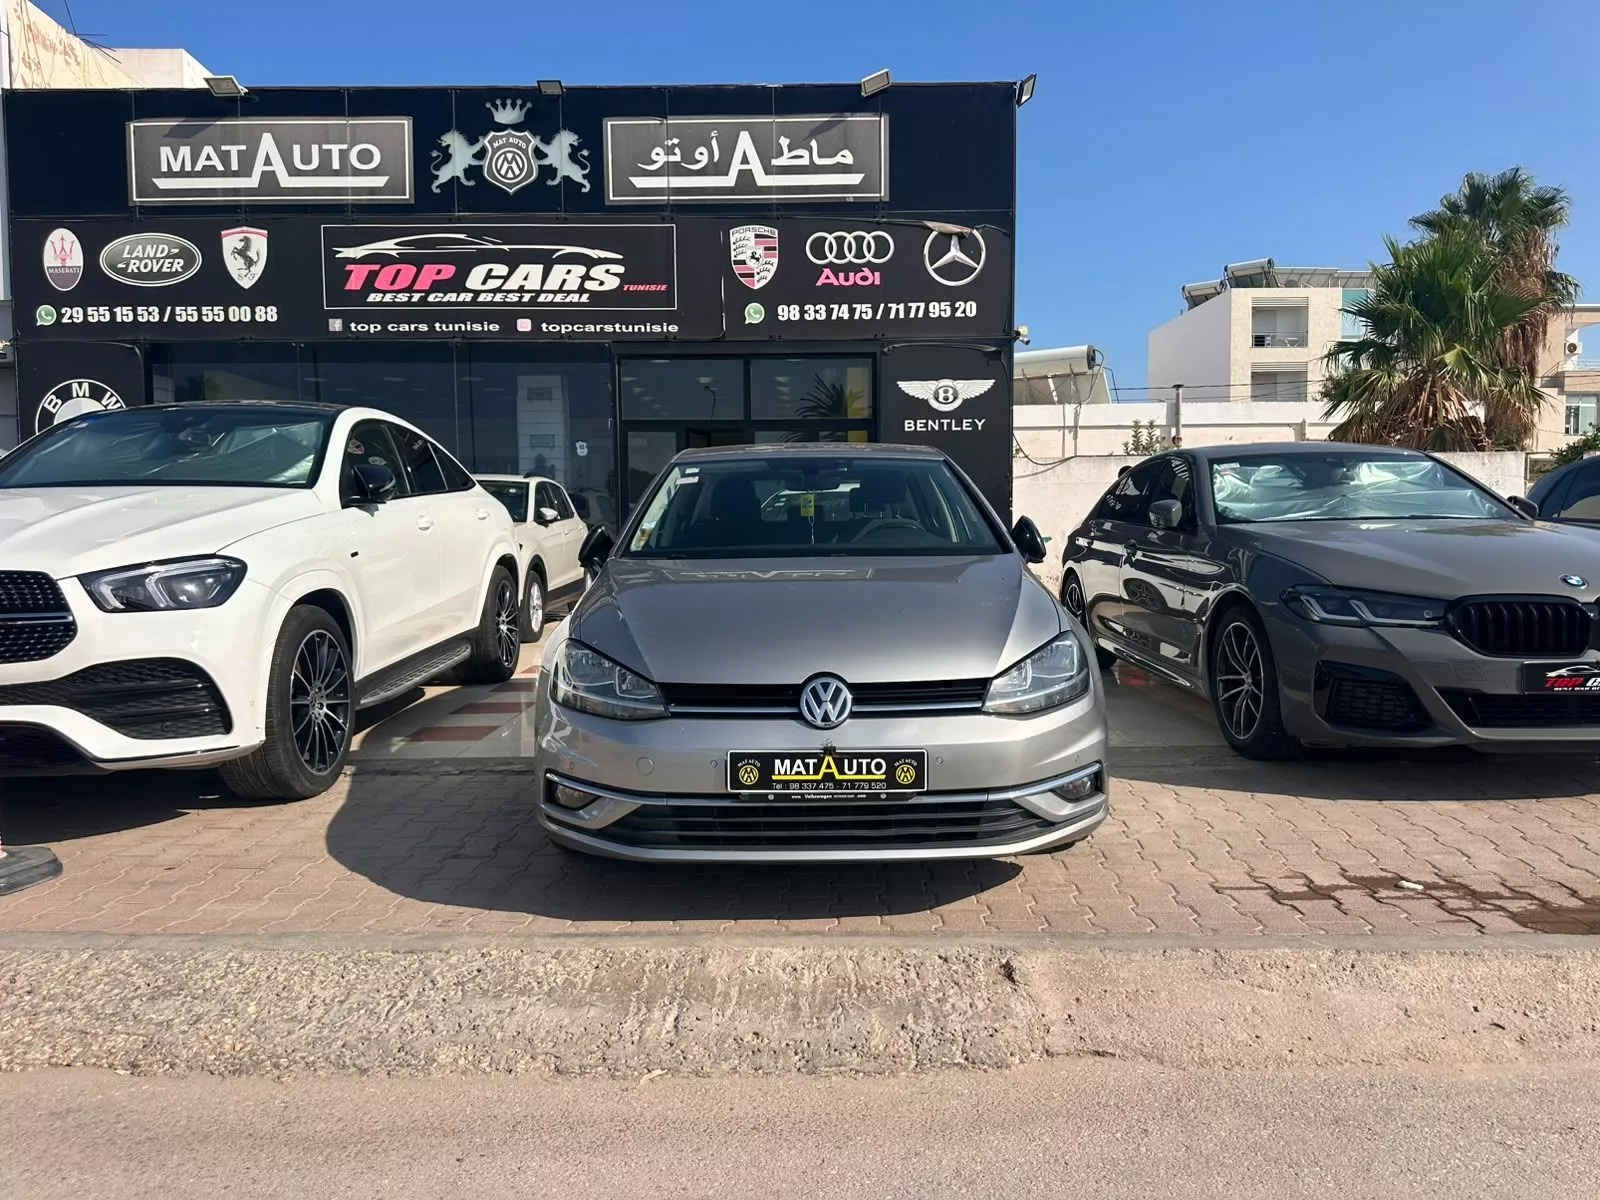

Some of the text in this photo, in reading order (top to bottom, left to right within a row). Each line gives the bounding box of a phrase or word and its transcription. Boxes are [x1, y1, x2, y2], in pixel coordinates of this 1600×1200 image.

[493, 137, 526, 149] MAT AUTO
[731, 226, 777, 237] PORSCHE
[48, 266, 81, 275] MASERATI
[127, 258, 185, 273] ROVER
[344, 263, 457, 291] TOP
[465, 263, 626, 292] CARS
[366, 292, 590, 303] BEST CAR BEST DEAL
[61, 306, 84, 323] 29
[87, 306, 111, 323] 55
[113, 306, 134, 323] 15
[137, 306, 160, 323] 53
[175, 306, 199, 323] 55
[201, 306, 225, 322] 55
[228, 305, 252, 322] 00
[254, 305, 278, 322] 88
[777, 304, 800, 321] 98
[803, 304, 827, 320] 33
[830, 303, 850, 320] 74
[852, 303, 873, 320] 75
[887, 303, 905, 319] 71
[907, 302, 925, 319] 77
[928, 302, 951, 318] 95
[954, 301, 977, 318] 20
[350, 322, 500, 333] top cars tunisie
[541, 322, 679, 333] topcarstunisie
[43, 382, 122, 414] BMW
[904, 418, 986, 431] BENTLEY
[789, 782, 800, 790] 98
[801, 782, 817, 790] 337
[818, 782, 835, 790] 475
